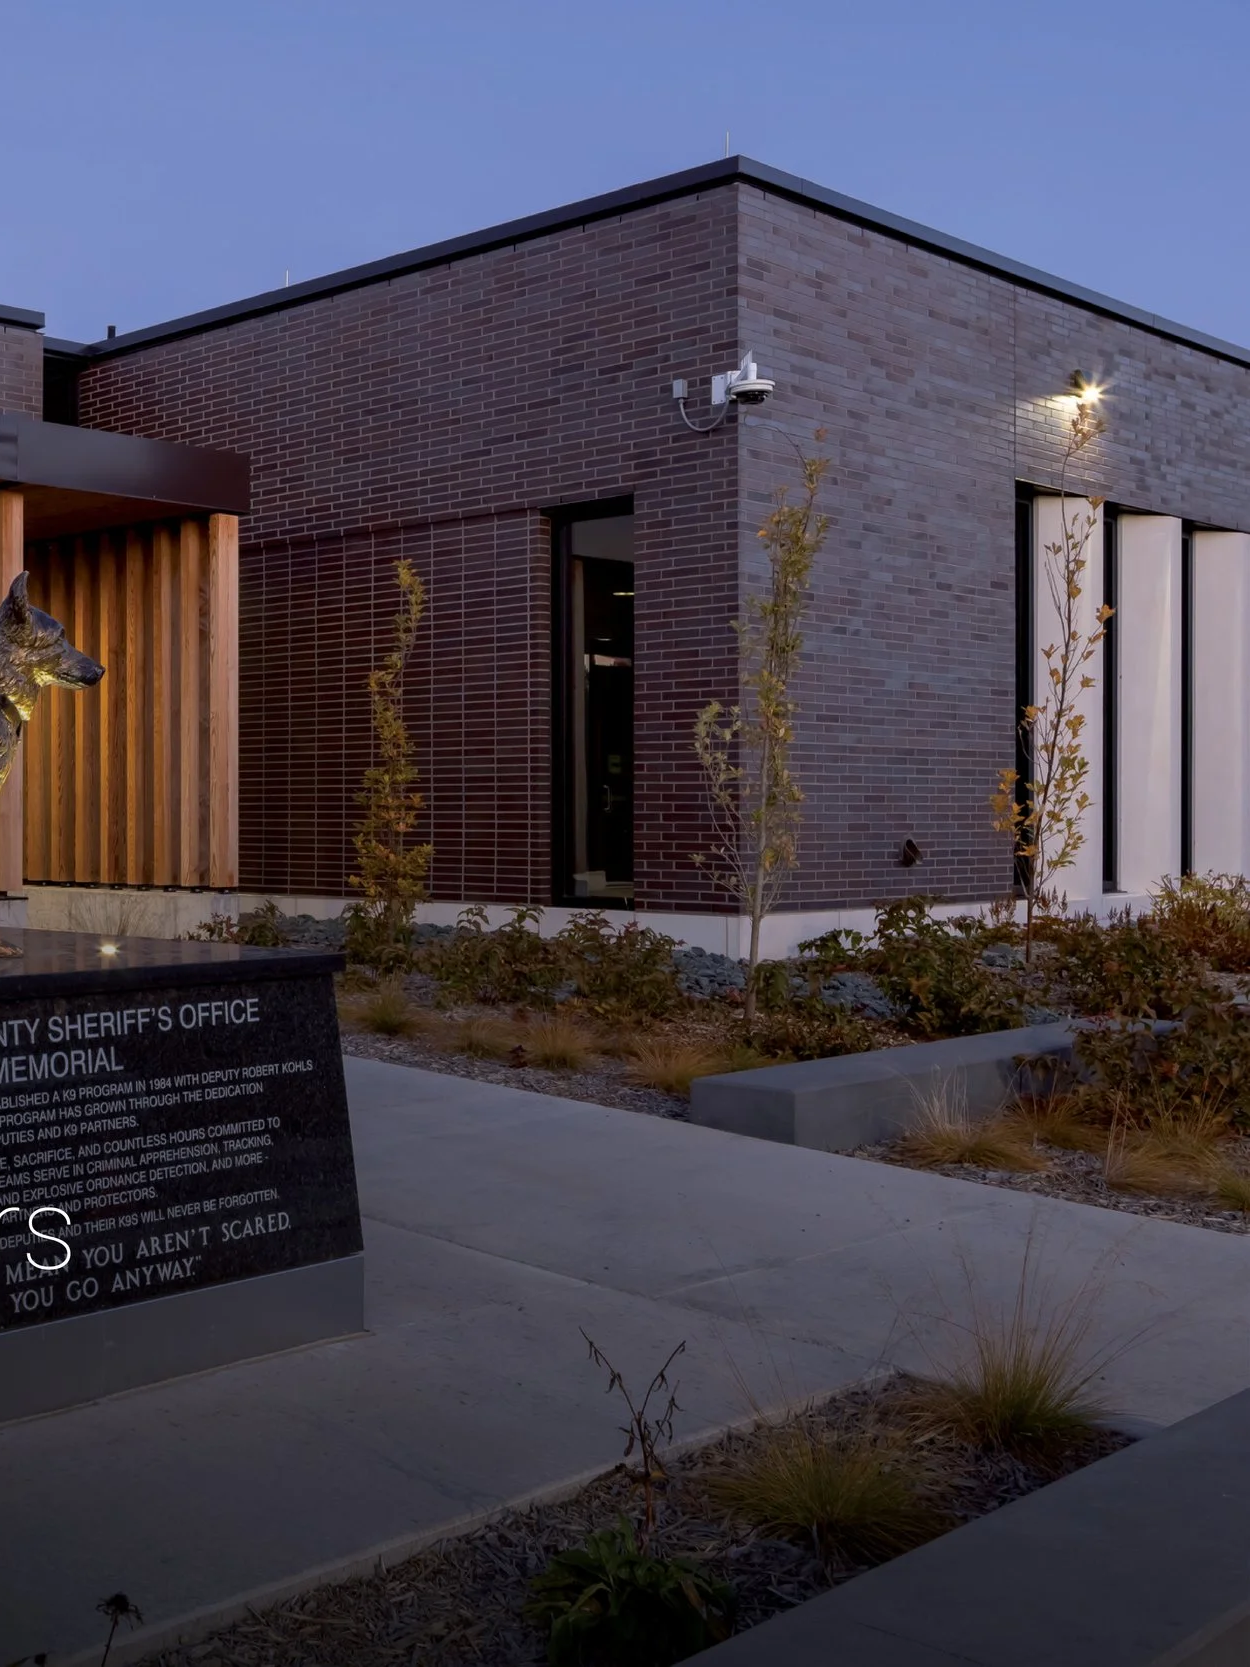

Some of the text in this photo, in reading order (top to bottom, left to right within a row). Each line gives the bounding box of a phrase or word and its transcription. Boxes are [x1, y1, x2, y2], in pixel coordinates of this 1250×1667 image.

[48, 1006, 172, 1043] SHERIFF'S
[179, 998, 260, 1029] OFFICE
[0, 1109, 56, 1128] PROGRAM
[59, 1105, 82, 1120] HAS
[84, 1101, 126, 1117] GROWN
[129, 1093, 180, 1110] THROUGH
[182, 1090, 202, 1103] THE
[205, 1081, 263, 1099] DEDICATION
[52, 1090, 60, 1103] A
[63, 1089, 76, 1101] K9
[79, 1081, 133, 1099] PROGRAM
[135, 1080, 146, 1092] IN
[149, 1078, 171, 1090] 1984
[174, 1073, 199, 1087] WITH
[201, 1068, 240, 1084] DEPUTY
[242, 1063, 281, 1079] ROBERT
[282, 1059, 313, 1074] KOHLS
[13, 1147, 75, 1168] SACRIFICE,
[78, 1143, 100, 1157] AND
[104, 1133, 167, 1154] COUNTLESS
[170, 1128, 205, 1144] HOURS
[208, 1119, 265, 1137] COMMITTED
[267, 1116, 280, 1129] TO
[37, 1126, 61, 1142] AND
[64, 1123, 78, 1136] K9
[80, 1115, 139, 1134] PARTNERS.
[23, 1181, 84, 1203] EXPLOSIVE
[86, 1171, 146, 1192] ORDNANCE
[149, 1162, 210, 1182] DETECTION,
[212, 1156, 232, 1171] AND
[235, 1152, 263, 1167] MORE
[33, 1165, 70, 1181] SERVE
[73, 1164, 84, 1176] IN
[86, 1156, 137, 1174] CRIMINAL
[139, 1142, 221, 1165] APPREHENSION,
[222, 1134, 274, 1150] TRACKING,
[58, 1198, 81, 1213] AND
[84, 1186, 158, 1208] PROTECTORS.
[58, 1223, 81, 1239] AND
[84, 1217, 117, 1234] THEIR
[119, 1213, 139, 1228] K9S
[140, 1209, 165, 1224] WILL
[167, 1201, 200, 1219] NEVER
[204, 1199, 217, 1213] BE
[219, 1188, 280, 1210] FORGOTTEN.
[5, 1254, 70, 1285] MEAN
[82, 1242, 123, 1269] YOU
[136, 1226, 210, 1260] AREN'T
[9, 1285, 54, 1313] YOU
[66, 1277, 99, 1301] GO
